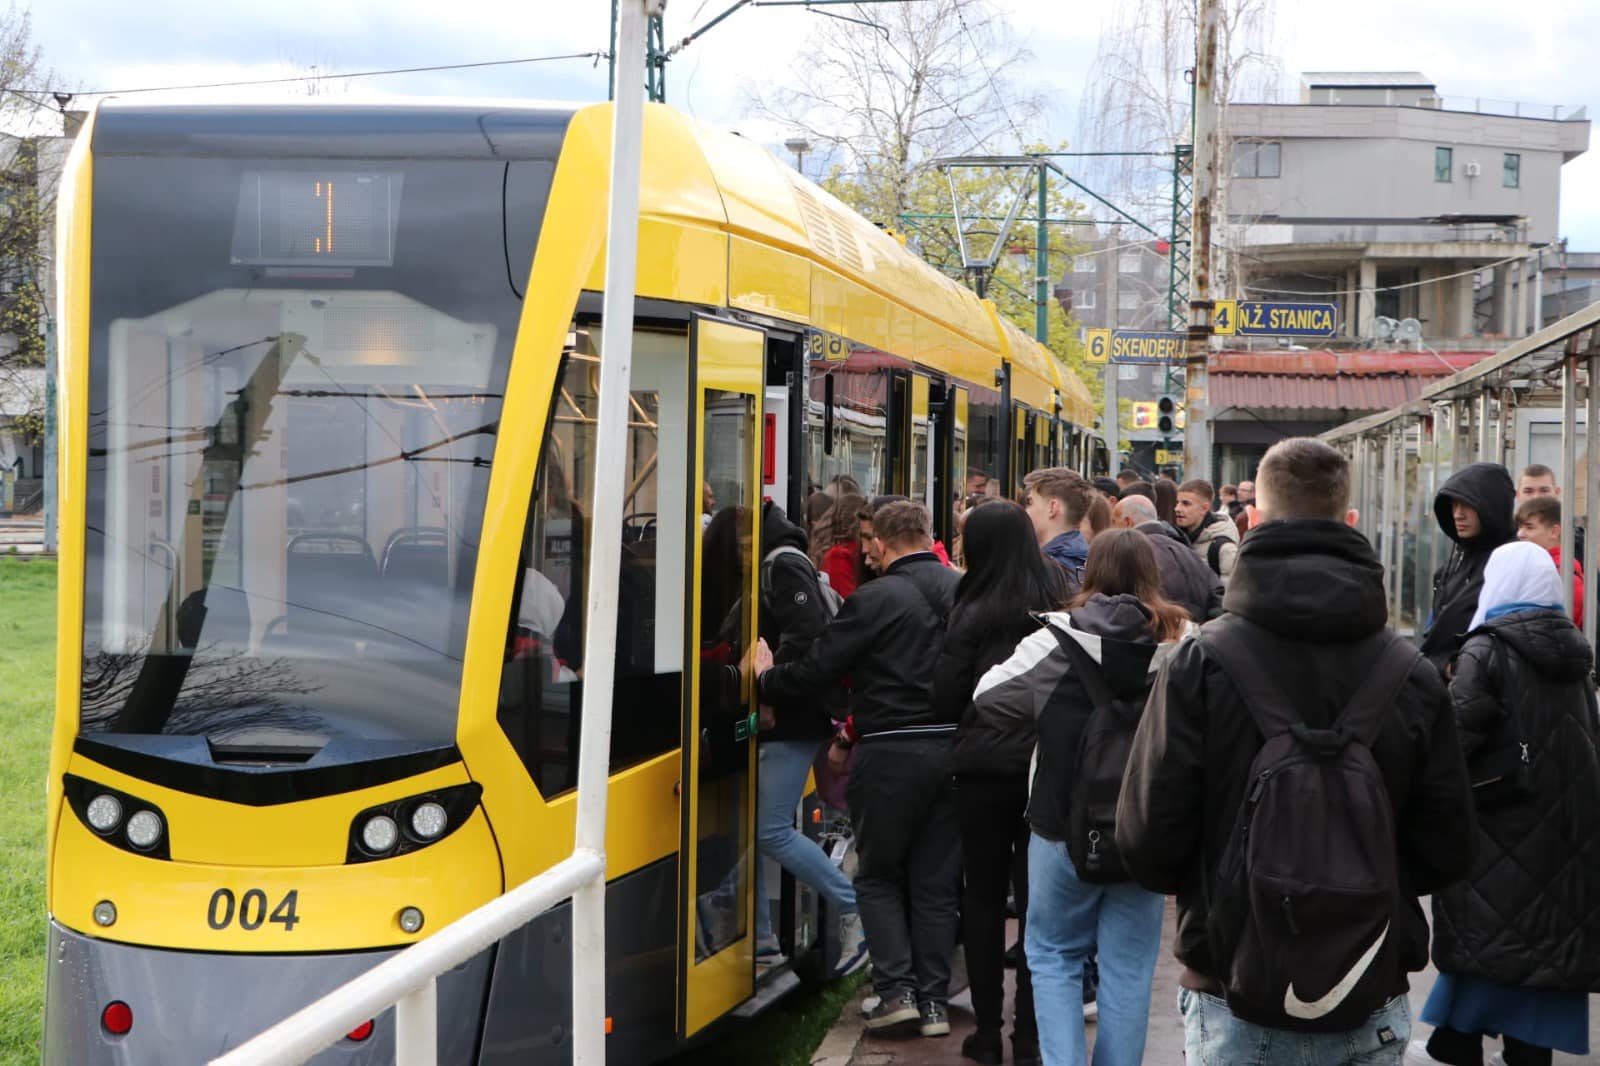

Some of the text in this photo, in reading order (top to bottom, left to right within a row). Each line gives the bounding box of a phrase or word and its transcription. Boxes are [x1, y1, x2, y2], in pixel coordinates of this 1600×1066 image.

[1215, 304, 1332, 330] 4 N.Ž. STANICA
[1091, 335, 1188, 358] 6 SKENDERIJ
[207, 888, 300, 931] 004
